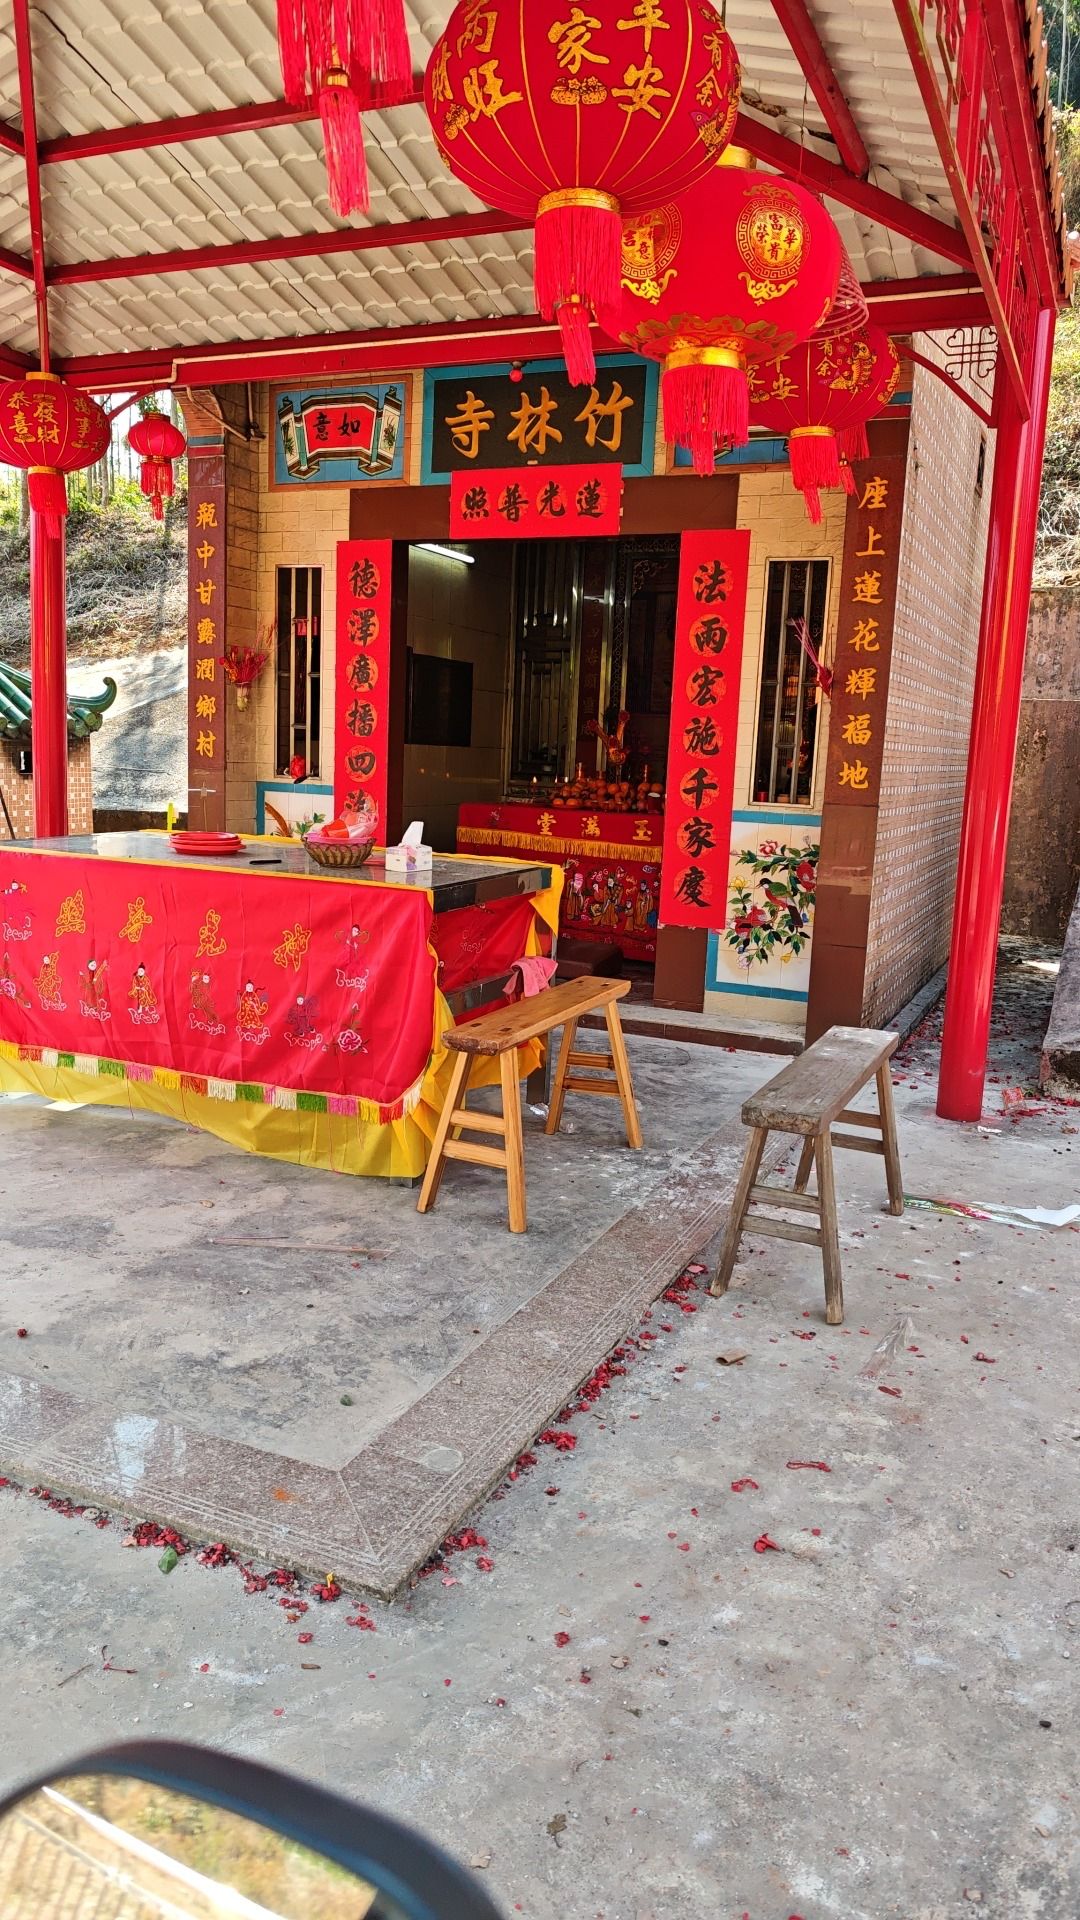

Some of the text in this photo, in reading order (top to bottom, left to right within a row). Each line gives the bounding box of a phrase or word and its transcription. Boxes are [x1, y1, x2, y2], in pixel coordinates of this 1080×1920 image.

[547, 0, 610, 74] 家
[611, 0, 671, 119] 平安
[313, 412, 361, 441] 如意
[445, 381, 634, 459] 竹林寺
[462, 478, 604, 523] 蓮光普照
[195, 502, 218, 757] 瓶中甘露潤鄉村
[838, 476, 888, 789] 座上蓮花輝福地
[674, 560, 728, 908] 法雨宏施千家慶
